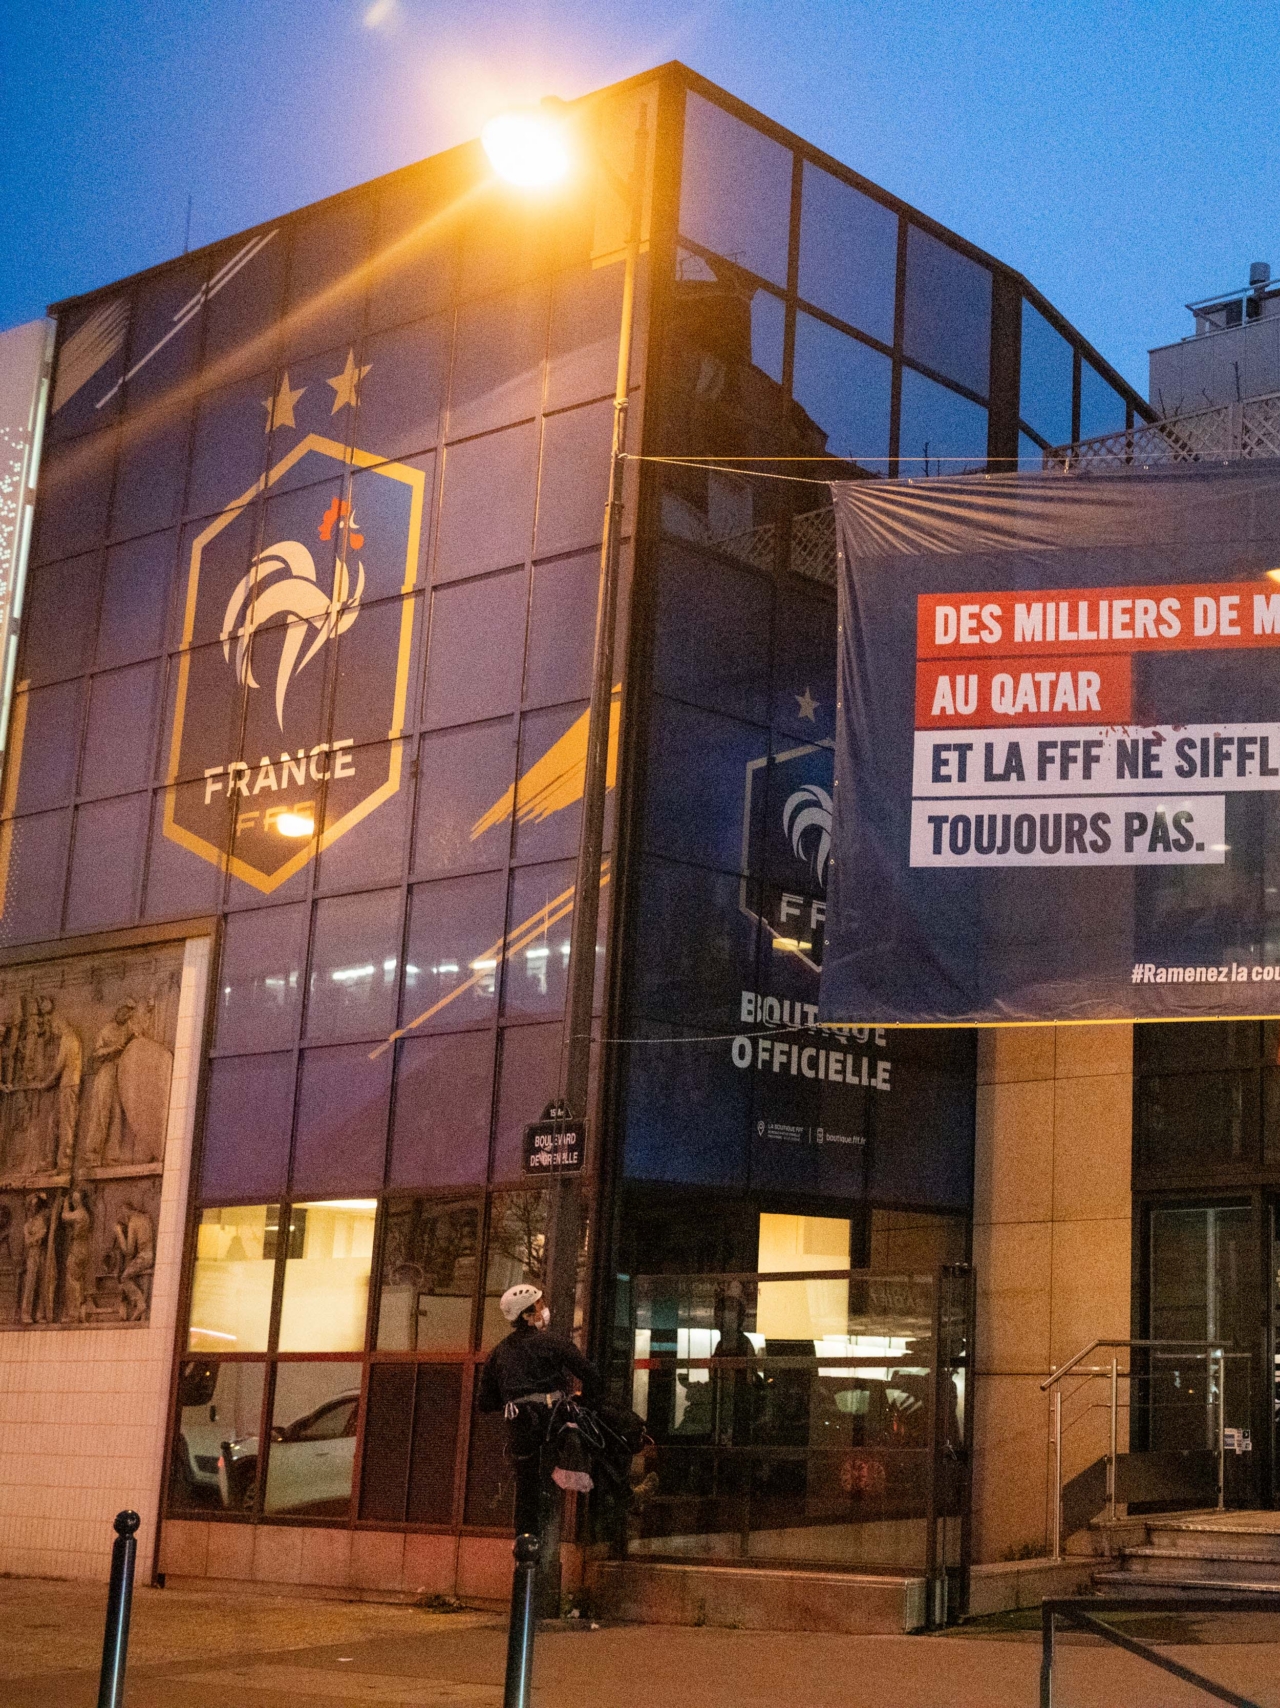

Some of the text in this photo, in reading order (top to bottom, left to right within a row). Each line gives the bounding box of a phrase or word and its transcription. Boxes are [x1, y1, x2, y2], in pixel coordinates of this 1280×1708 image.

[935, 605, 1002, 645] DES
[1014, 599, 1181, 642] MILLIERS
[1194, 596, 1241, 637] DE
[931, 671, 1101, 716] AU QATAR
[204, 738, 356, 805] FRANCE
[931, 743, 973, 783] ET
[984, 741, 1025, 781] LA
[1037, 740, 1103, 780] FFF
[1116, 738, 1163, 779] NE
[928, 811, 1206, 855] TOUJOURS PAS.
[781, 893, 827, 929] FF
[1131, 964, 1228, 983] #Ramenez
[1231, 963, 1248, 982] la
[731, 1036, 892, 1092] OFFICIELLE
